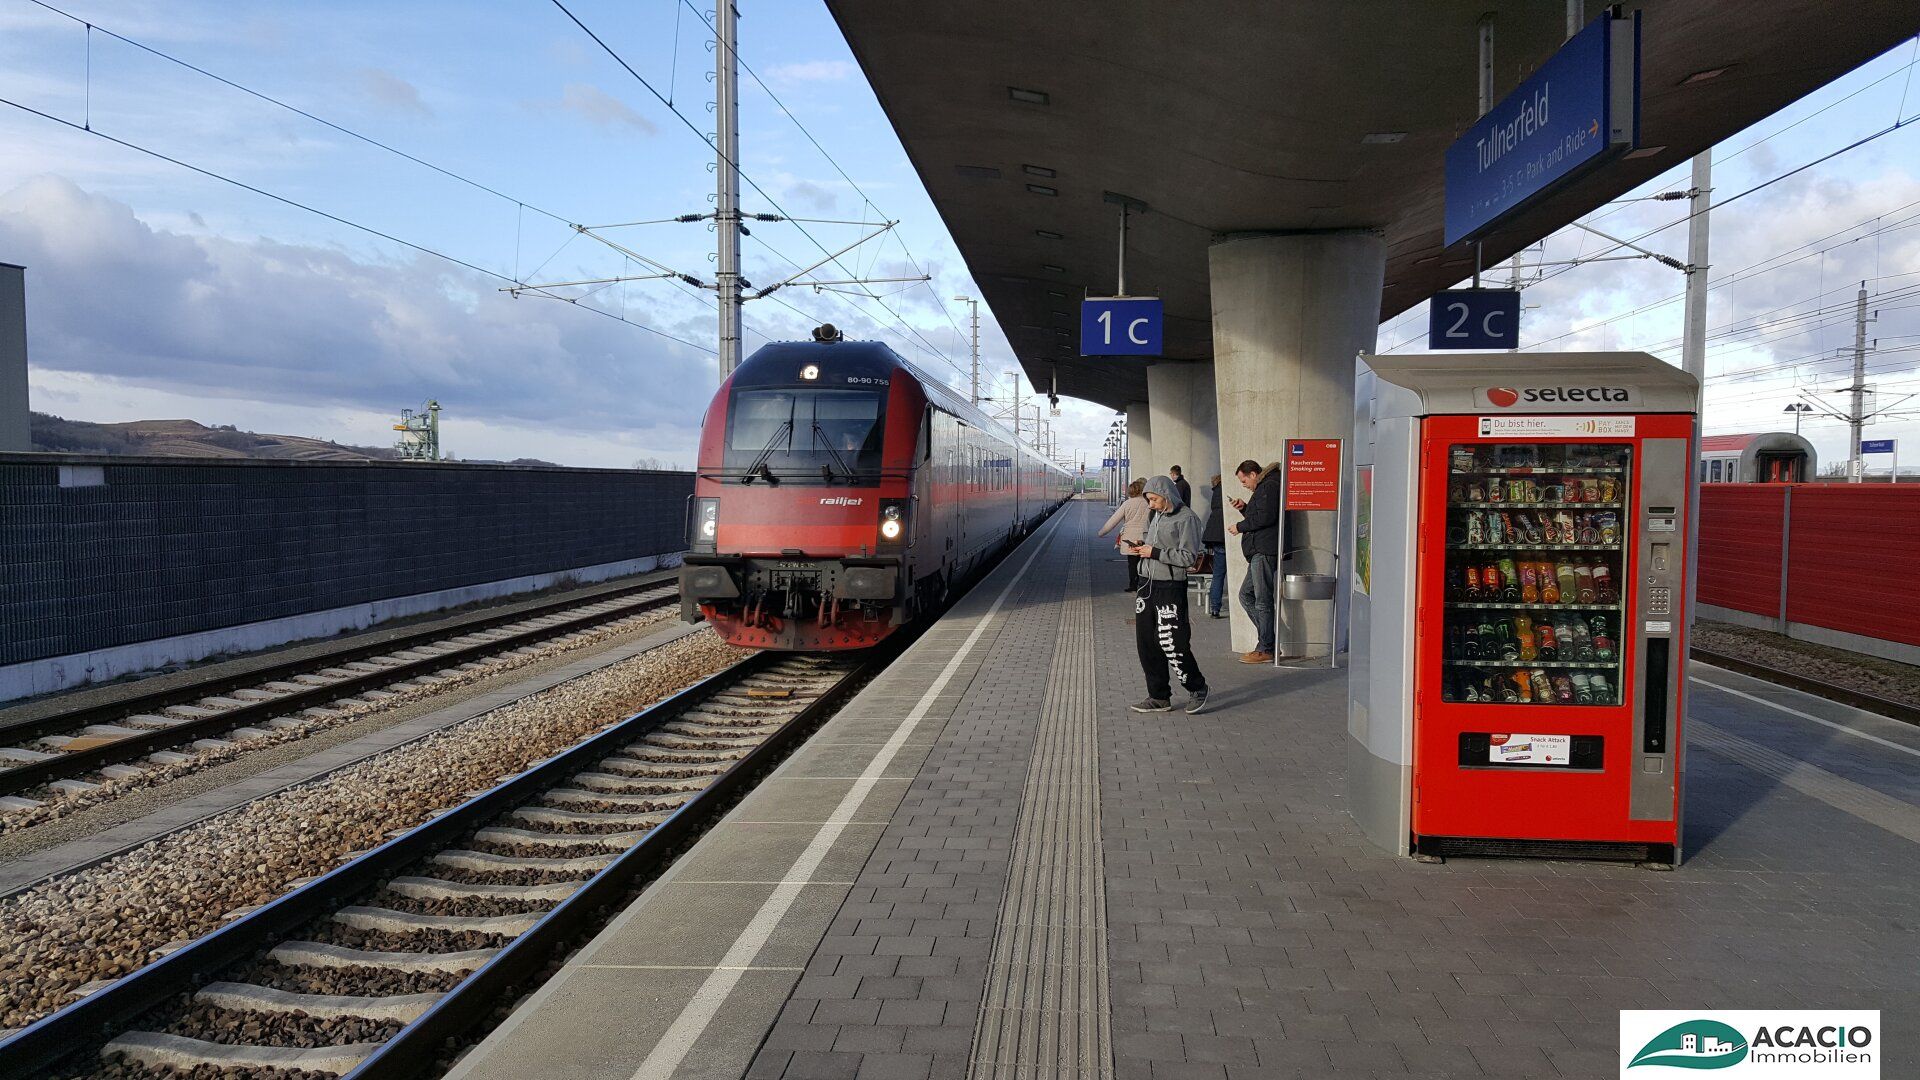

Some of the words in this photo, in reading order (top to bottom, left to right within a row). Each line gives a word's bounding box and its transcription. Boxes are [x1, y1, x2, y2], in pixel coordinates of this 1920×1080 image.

[1477, 81, 1549, 174] Tullnerfeld
[1526, 155, 1544, 181] Park
[1546, 139, 1563, 169] and
[1566, 128, 1586, 156] Ride
[1097, 310, 1111, 345] 1
[1128, 317, 1149, 345] c
[1445, 302, 1470, 338] 2
[1482, 310, 1505, 338] c
[847, 376, 872, 384] 80-90
[1523, 386, 1630, 402] selecta
[1494, 419, 1508, 428] Du
[1509, 419, 1524, 428] bist
[1525, 418, 1547, 428] hier.
[819, 496, 863, 507] railjet
